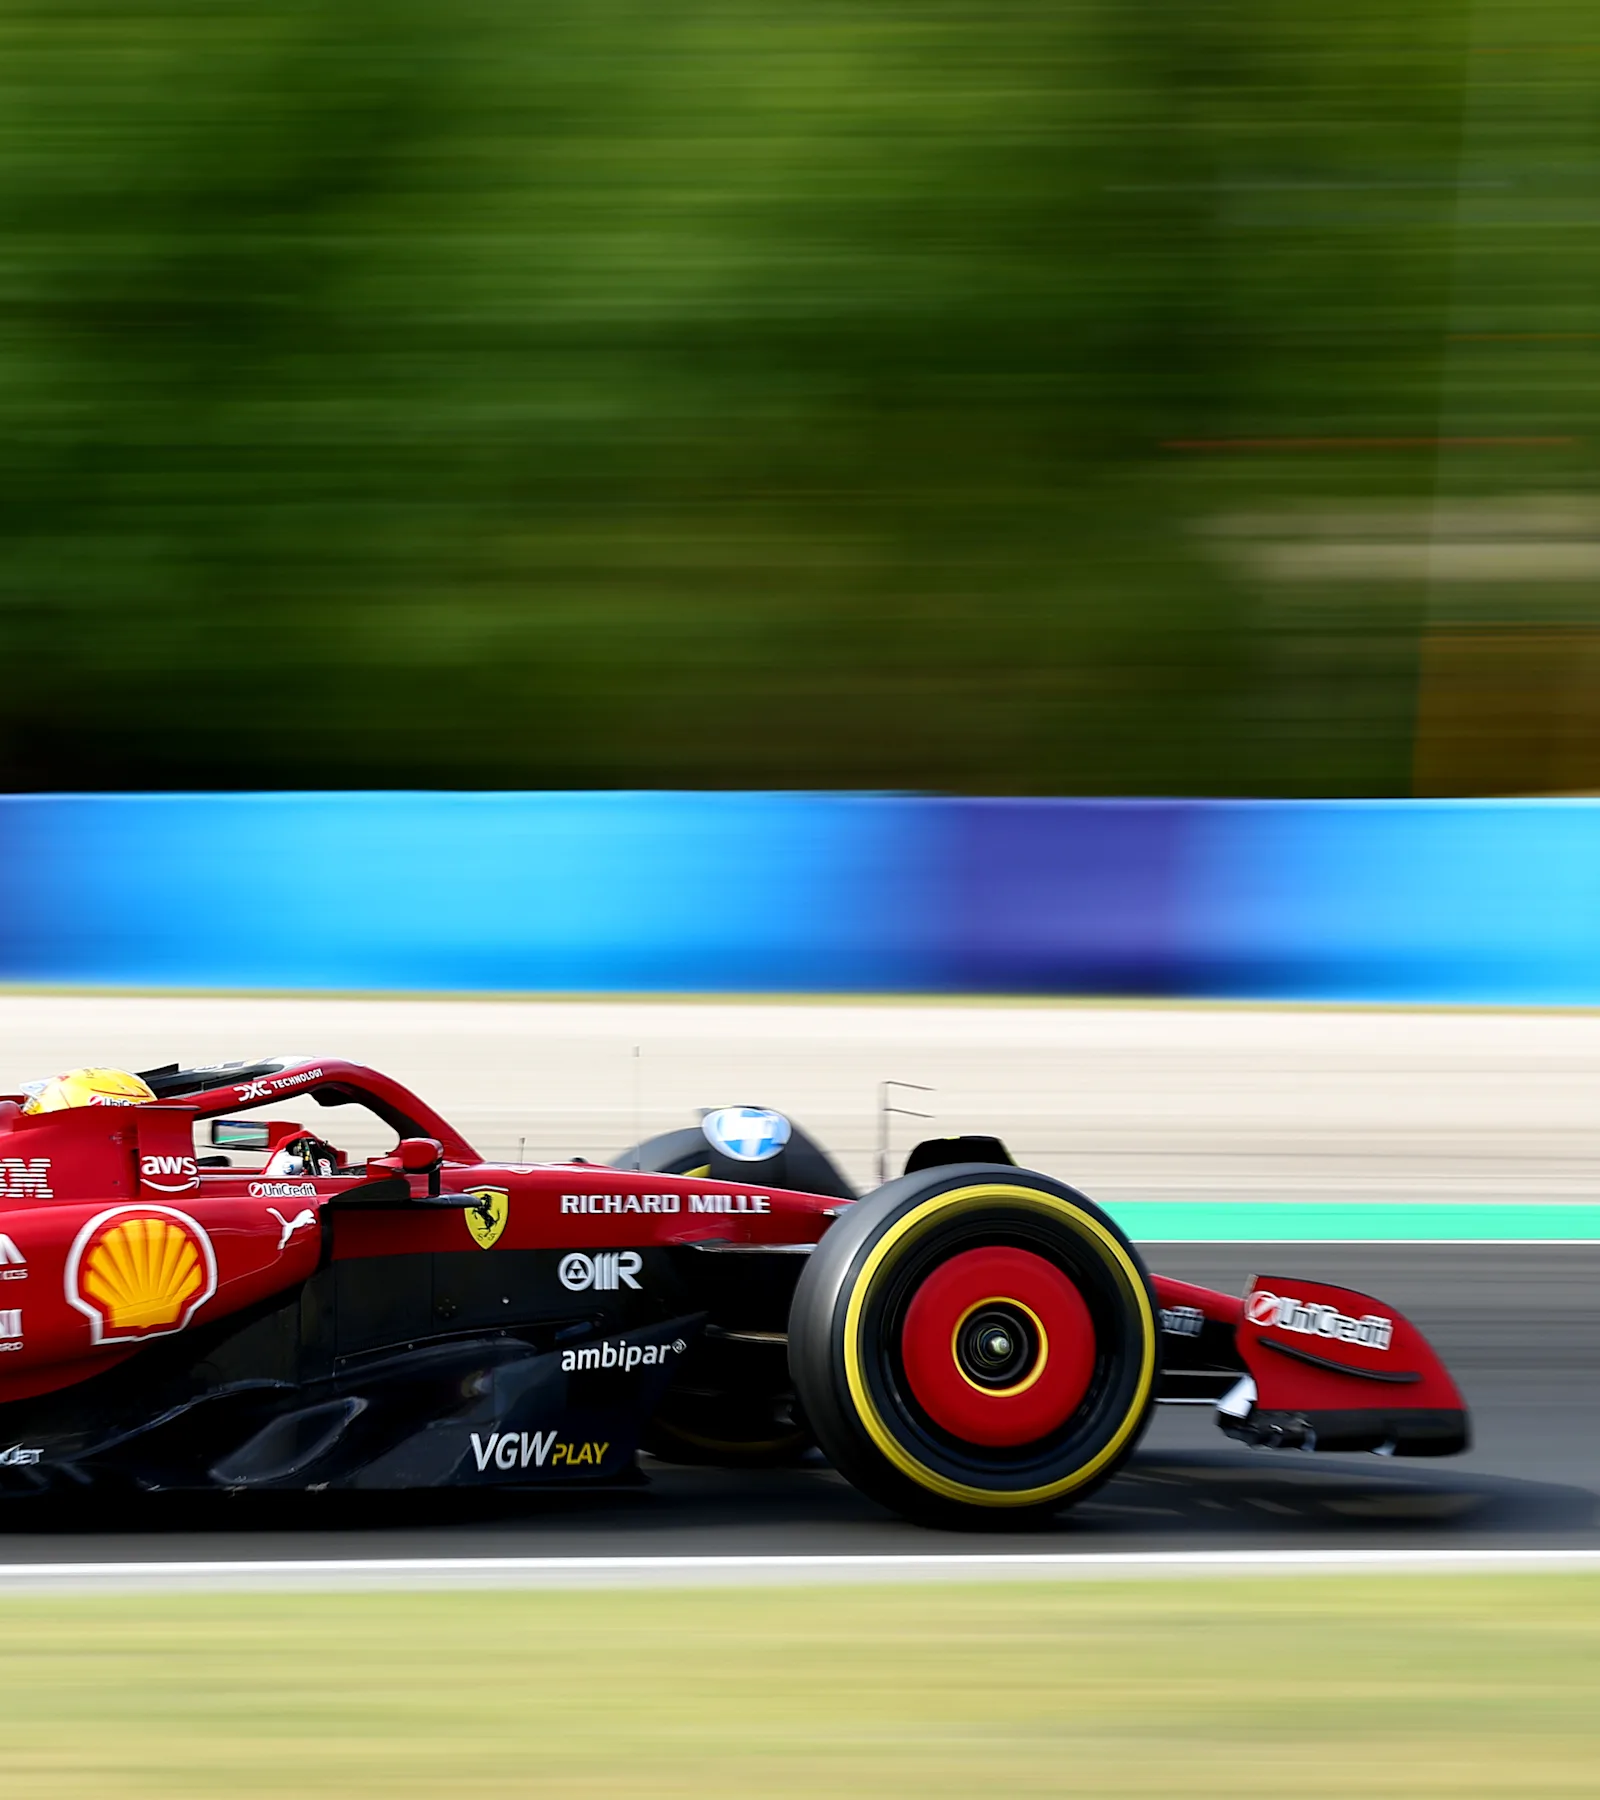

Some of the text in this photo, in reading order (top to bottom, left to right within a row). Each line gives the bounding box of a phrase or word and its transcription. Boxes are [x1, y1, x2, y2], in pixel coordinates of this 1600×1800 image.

[233, 1068, 323, 1102] DXC TECHNOLOGY
[141, 1155, 197, 1176] aws
[264, 1183, 315, 1196] UniCredit
[560, 1195, 771, 1214] RICHARD MILLE
[1273, 1296, 1393, 1351] UniCredit
[561, 1341, 671, 1371] ambipar
[469, 1431, 609, 1471] VGW PLAY
